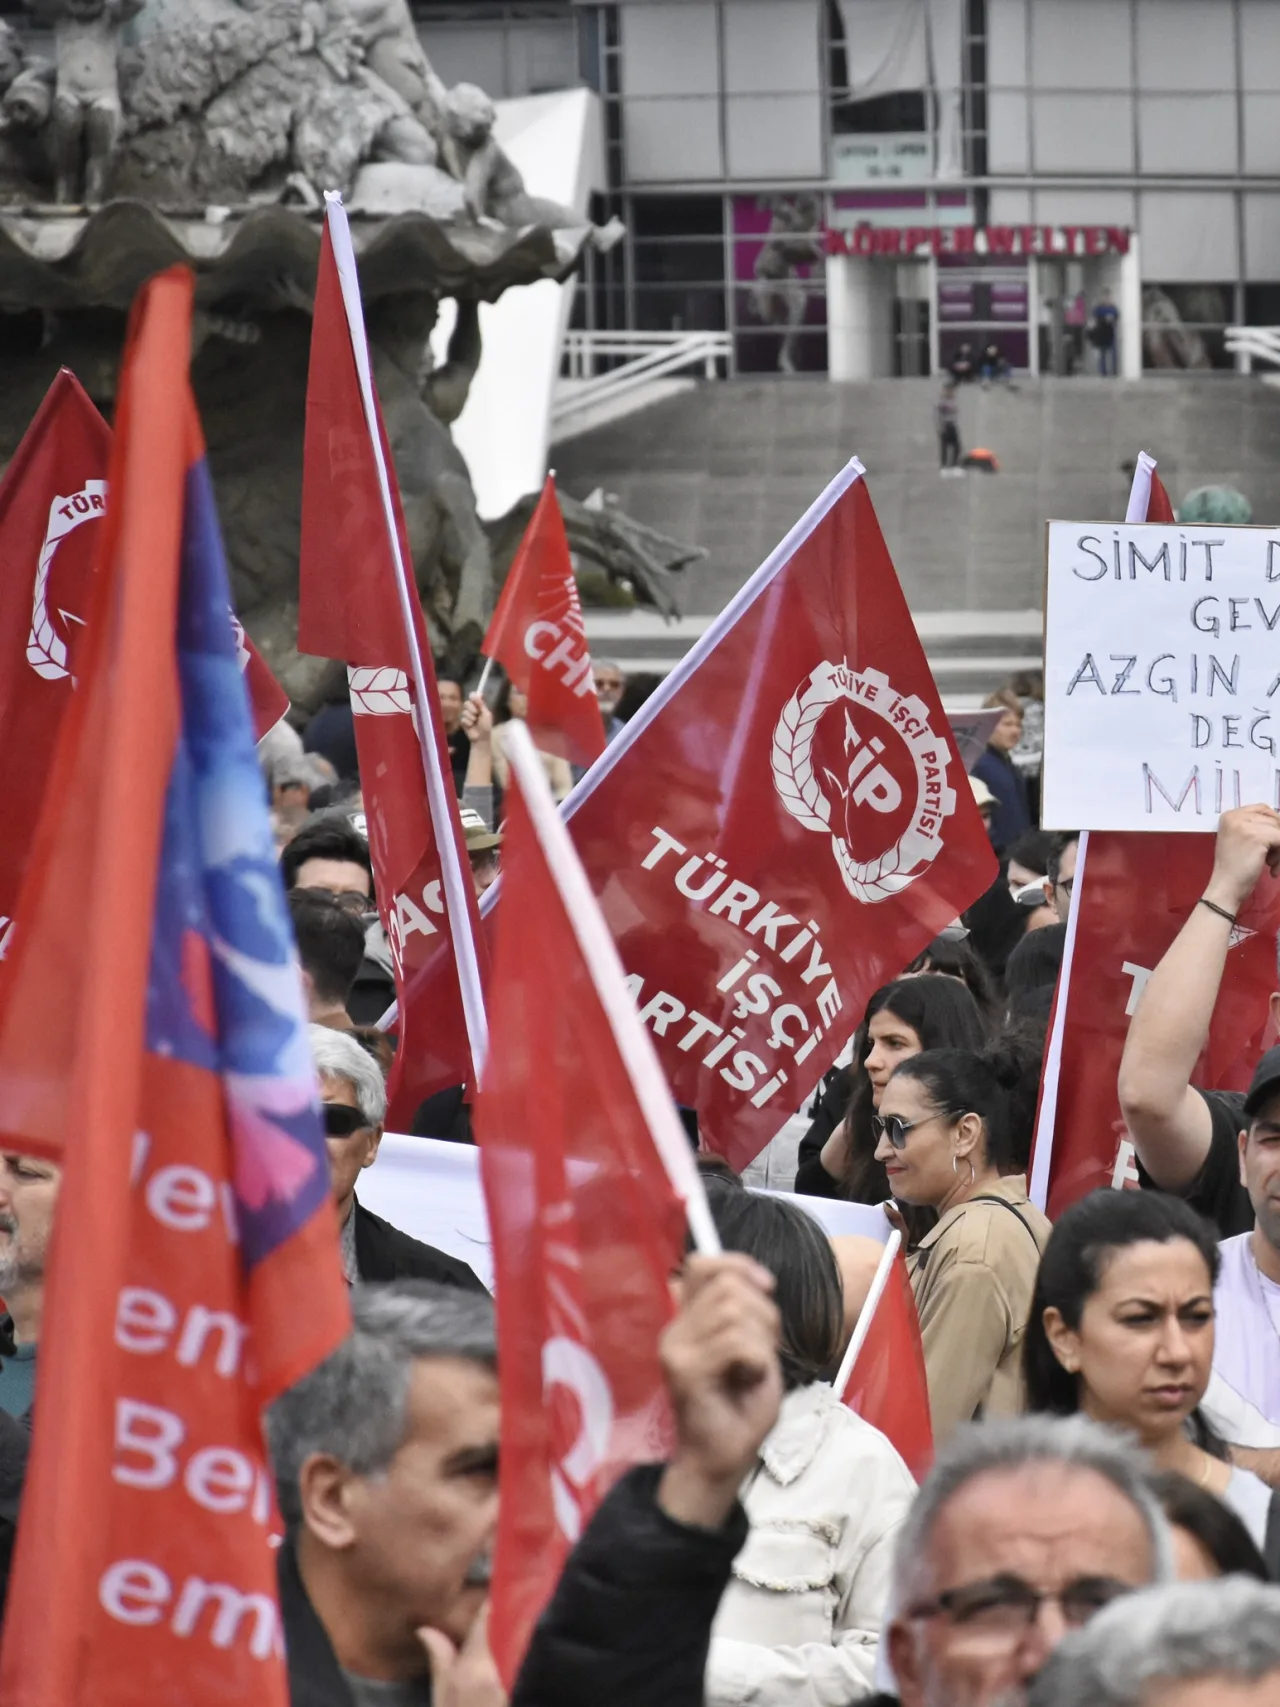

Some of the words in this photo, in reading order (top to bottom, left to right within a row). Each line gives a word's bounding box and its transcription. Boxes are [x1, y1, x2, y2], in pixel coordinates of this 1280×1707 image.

[1072, 531, 1226, 582] SİMİT
[1065, 652, 1240, 703] AZGIN
[888, 696, 928, 740] İŞÇİ
[916, 750, 942, 840] PARTİSİ
[640, 826, 843, 1030] TÜRKİYE
[626, 973, 788, 1108] ARTİSİ
[716, 950, 823, 1066] İŞÇİ
